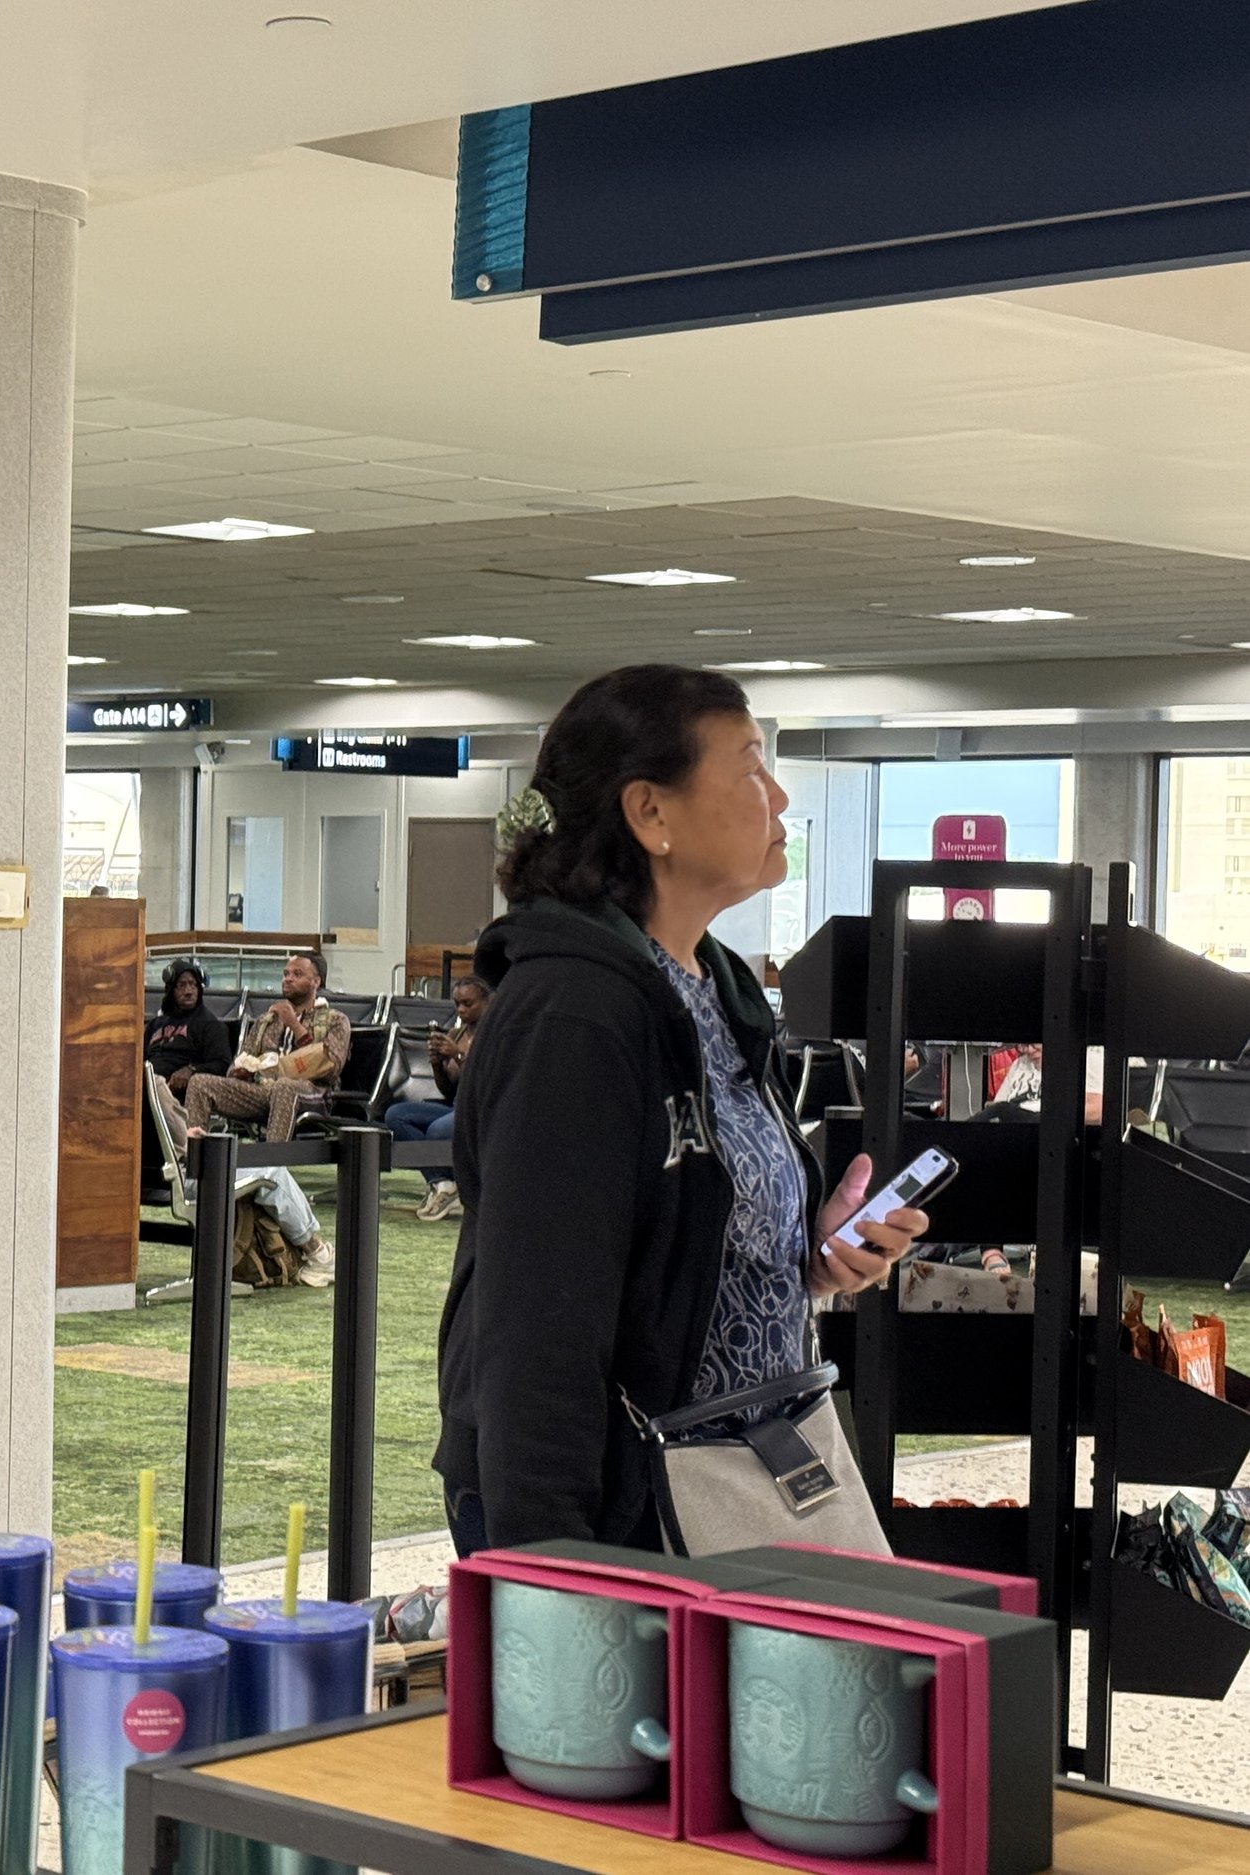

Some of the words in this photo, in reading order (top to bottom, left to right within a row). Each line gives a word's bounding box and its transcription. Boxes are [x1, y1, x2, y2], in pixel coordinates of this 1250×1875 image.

[93, 708, 122, 726] Gate
[122, 707, 146, 725] A14
[336, 750, 386, 768] Restrooms
[941, 841, 966, 852] More
[967, 843, 998, 853] power
